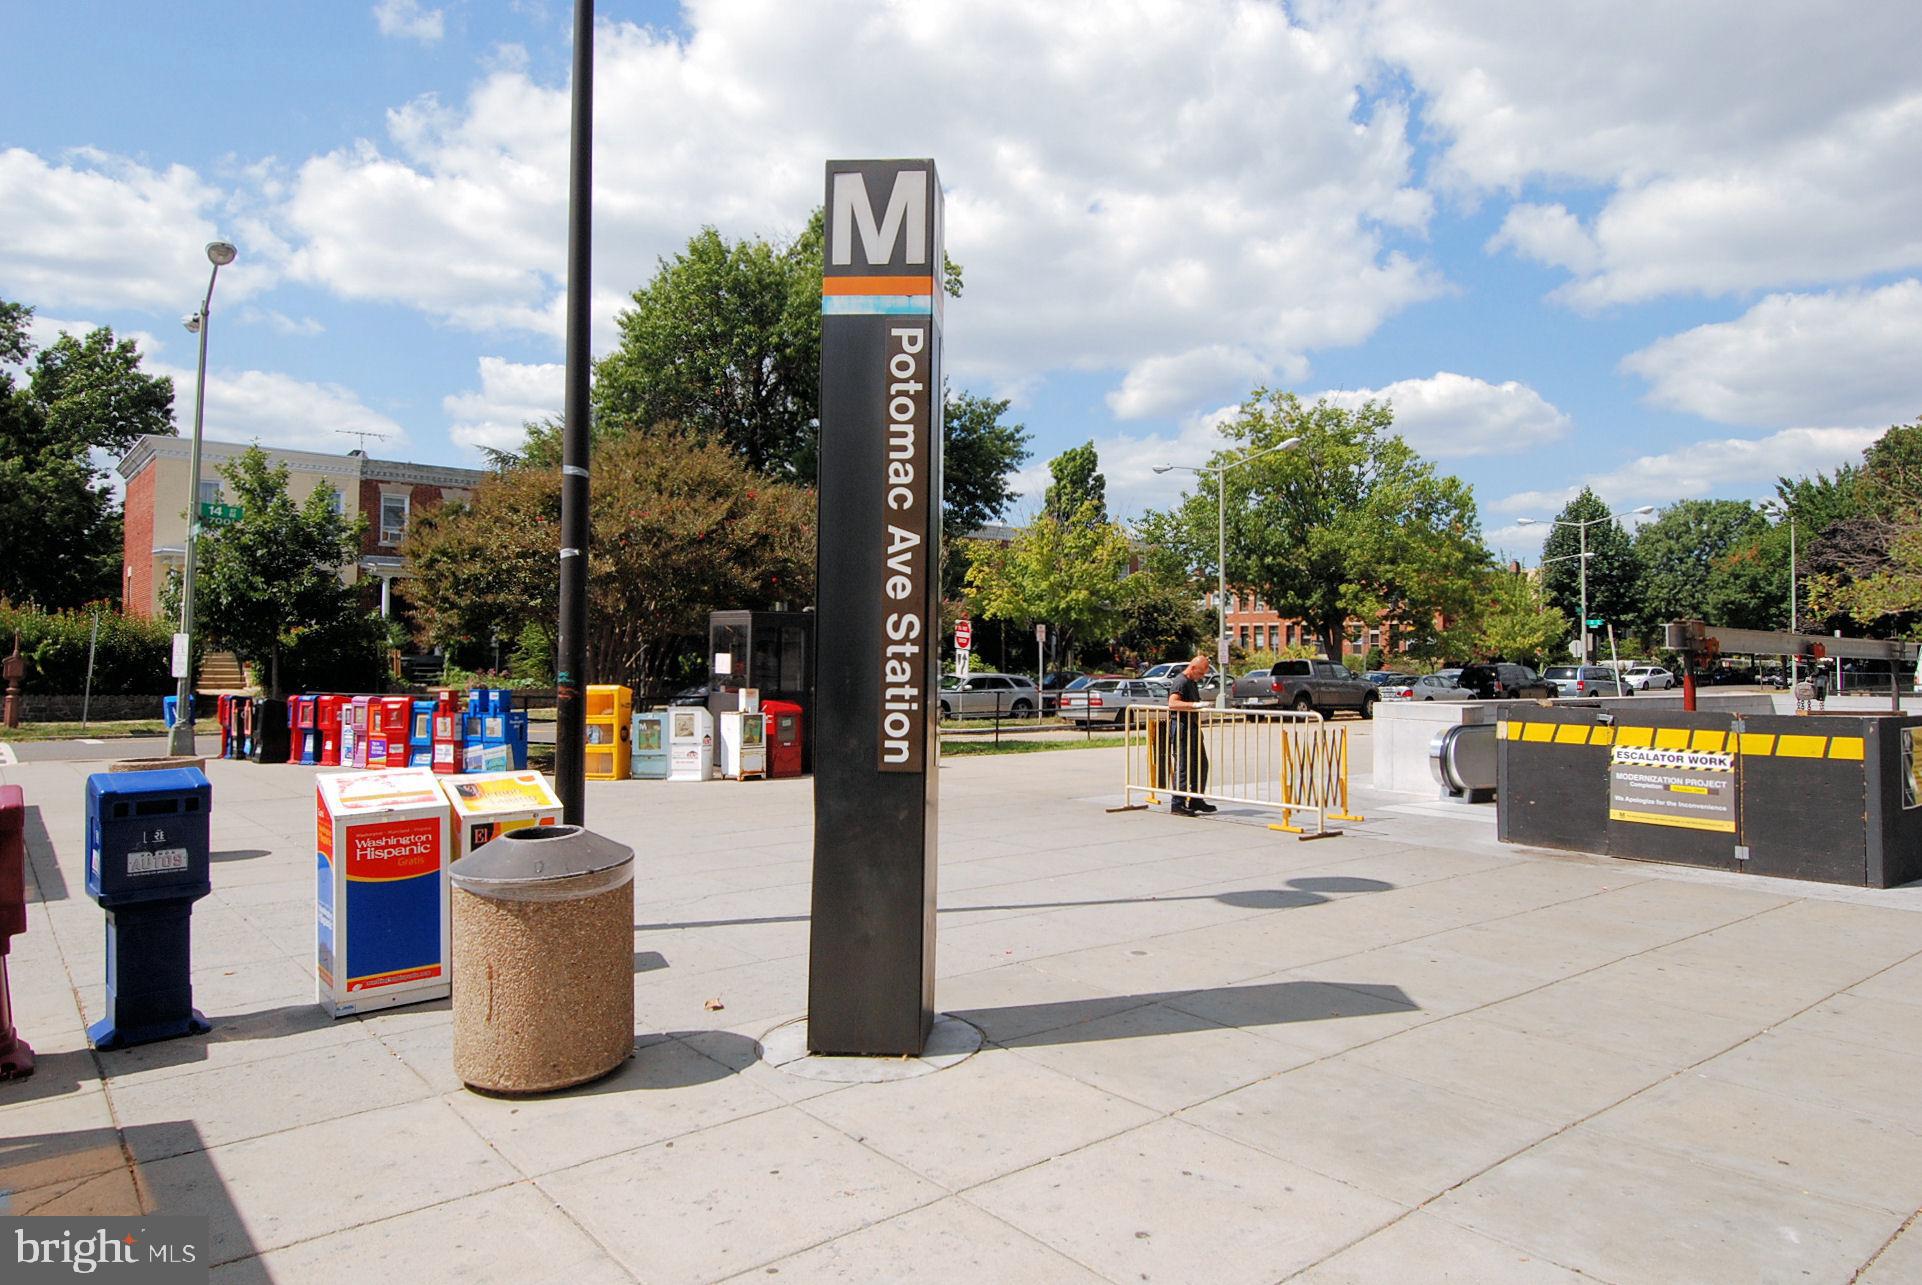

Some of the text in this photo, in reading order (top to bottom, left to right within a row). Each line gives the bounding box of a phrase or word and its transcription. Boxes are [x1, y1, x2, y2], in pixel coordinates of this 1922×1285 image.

[832, 170, 927, 266] M
[208, 506, 223, 516] 14
[883, 328, 924, 764] Potomac Ave Station
[1616, 750, 1727, 766] ESCALATOR WORK
[1615, 772, 1728, 788] MODERNIZATION PROJECT
[1625, 796, 1655, 805] Apologize
[1678, 801, 1728, 812] Inconvenience
[355, 833, 432, 849] Washington
[474, 828, 488, 844] El
[356, 843, 432, 861] Hispanic
[397, 856, 425, 867] Gratis
